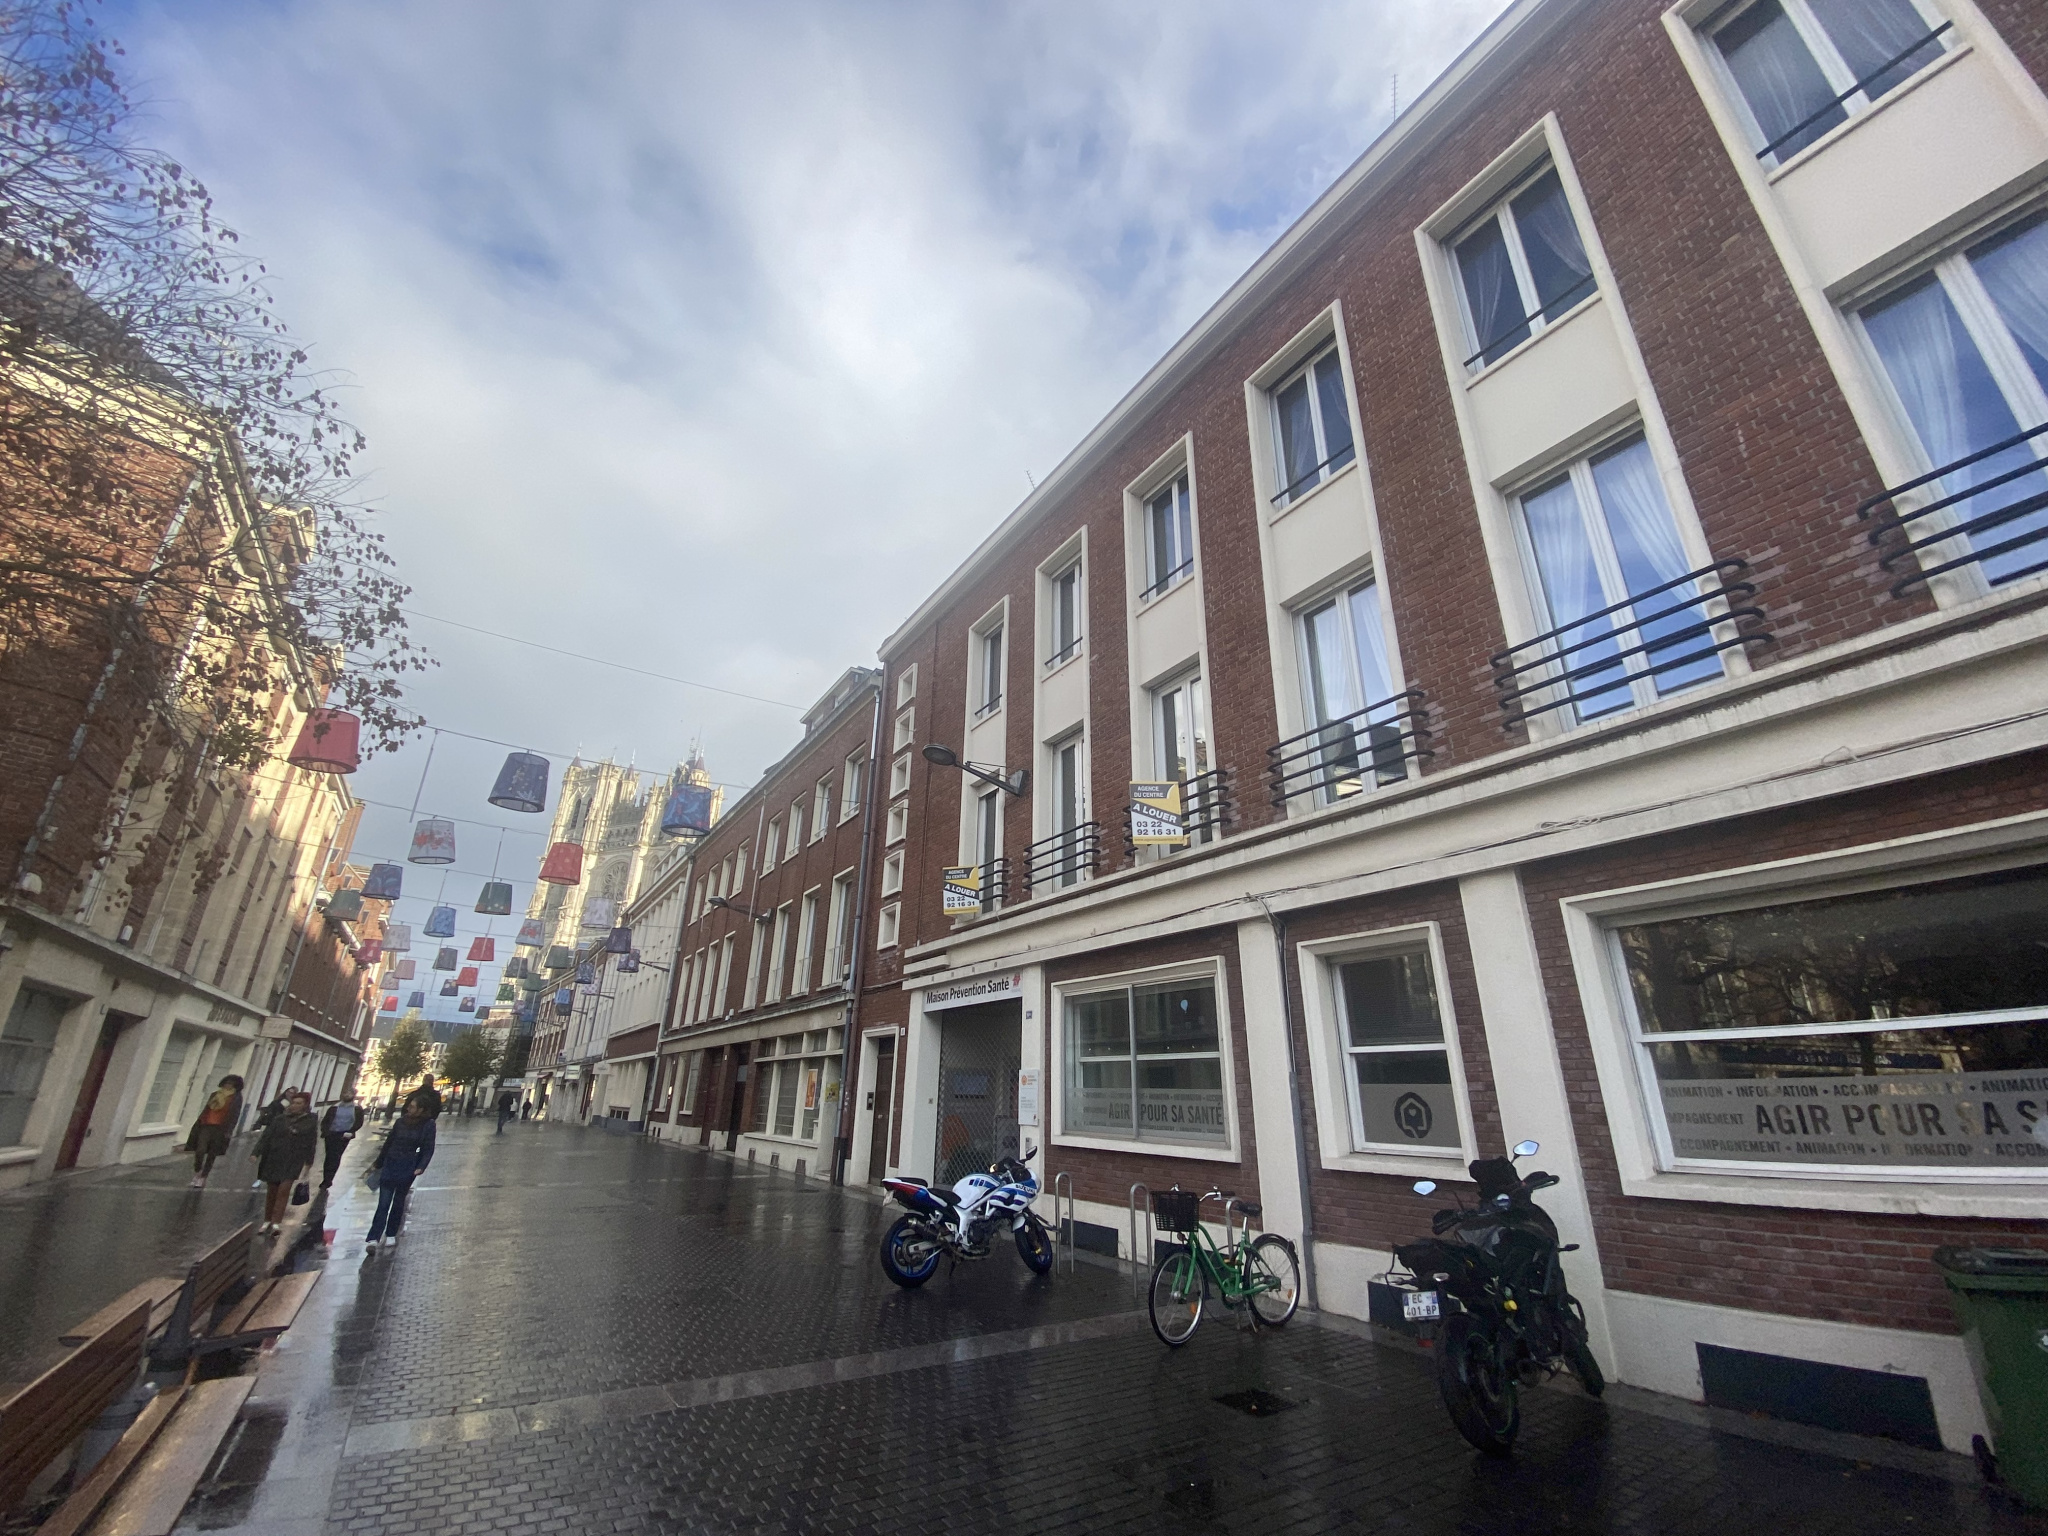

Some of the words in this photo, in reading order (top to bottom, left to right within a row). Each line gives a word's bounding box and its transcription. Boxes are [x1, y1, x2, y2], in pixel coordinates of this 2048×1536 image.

[1132, 803, 1141, 812] A
[1142, 805, 1177, 824] LOUER
[951, 885, 976, 897] LOUER
[926, 989, 949, 1004] Maison
[949, 982, 987, 1000] Prévention
[987, 976, 1010, 994] Santé
[1664, 1086, 1724, 1098] ANIMATION
[1108, 1103, 1131, 1120] AGIR
[1140, 1103, 1169, 1122] POUR
[1171, 1104, 1186, 1124] SA
[1187, 1103, 1224, 1126] SANTÉ
[1755, 1104, 1832, 1135] AGIR
[1676, 1138, 1782, 1153] CCOMPAGNEMENT
[1411, 1293, 1423, 1304] EC
[1406, 1304, 1437, 1317] 401-BP
